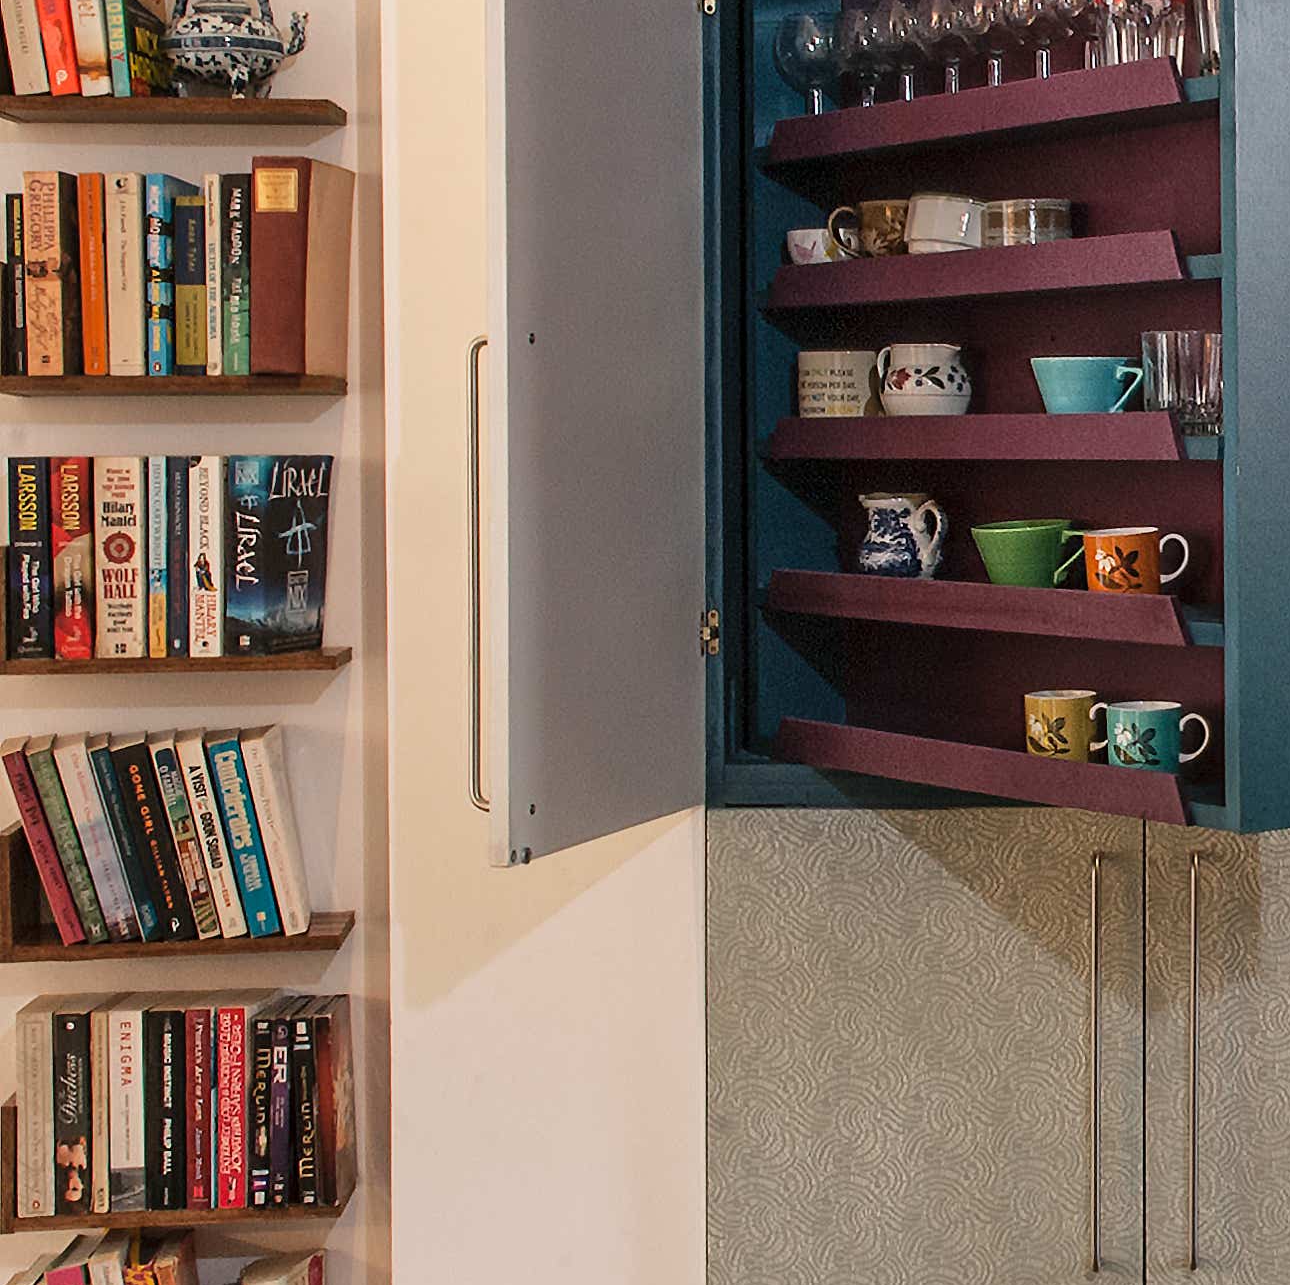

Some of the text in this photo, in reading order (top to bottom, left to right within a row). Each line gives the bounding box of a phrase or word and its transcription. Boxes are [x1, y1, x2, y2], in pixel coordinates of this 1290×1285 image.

[28, 180, 42, 252] GREGORY
[42, 182, 56, 251] PHILIPPA
[229, 188, 242, 265] MARK HADDON
[17, 465, 37, 530] LARSSON
[60, 465, 80, 530] LARSSON
[101, 514, 136, 527] Mantel
[103, 501, 135, 515] Hilary
[199, 467, 209, 549] BEYOND BLACK
[102, 568, 138, 584] WOLF
[103, 584, 137, 599] HALL
[195, 594, 205, 642] MANTEL
[206, 594, 217, 637] HILARY
[128, 765, 155, 836] GONE GIRL
[188, 765, 208, 799] A VISIT
[214, 750, 252, 850] Confederates
[199, 812, 224, 869] GOON SQUAD
[120, 1021, 132, 1087] ENIGMA
[163, 1033, 173, 1108] MUSIC INSTINCT
[273, 1046, 287, 1083] ER
[59, 1053, 78, 1123] Duchess
[230, 1025, 242, 1173] JONATHAN SAFRAN FOER
[163, 1118, 173, 1175] PHILIP BALL
